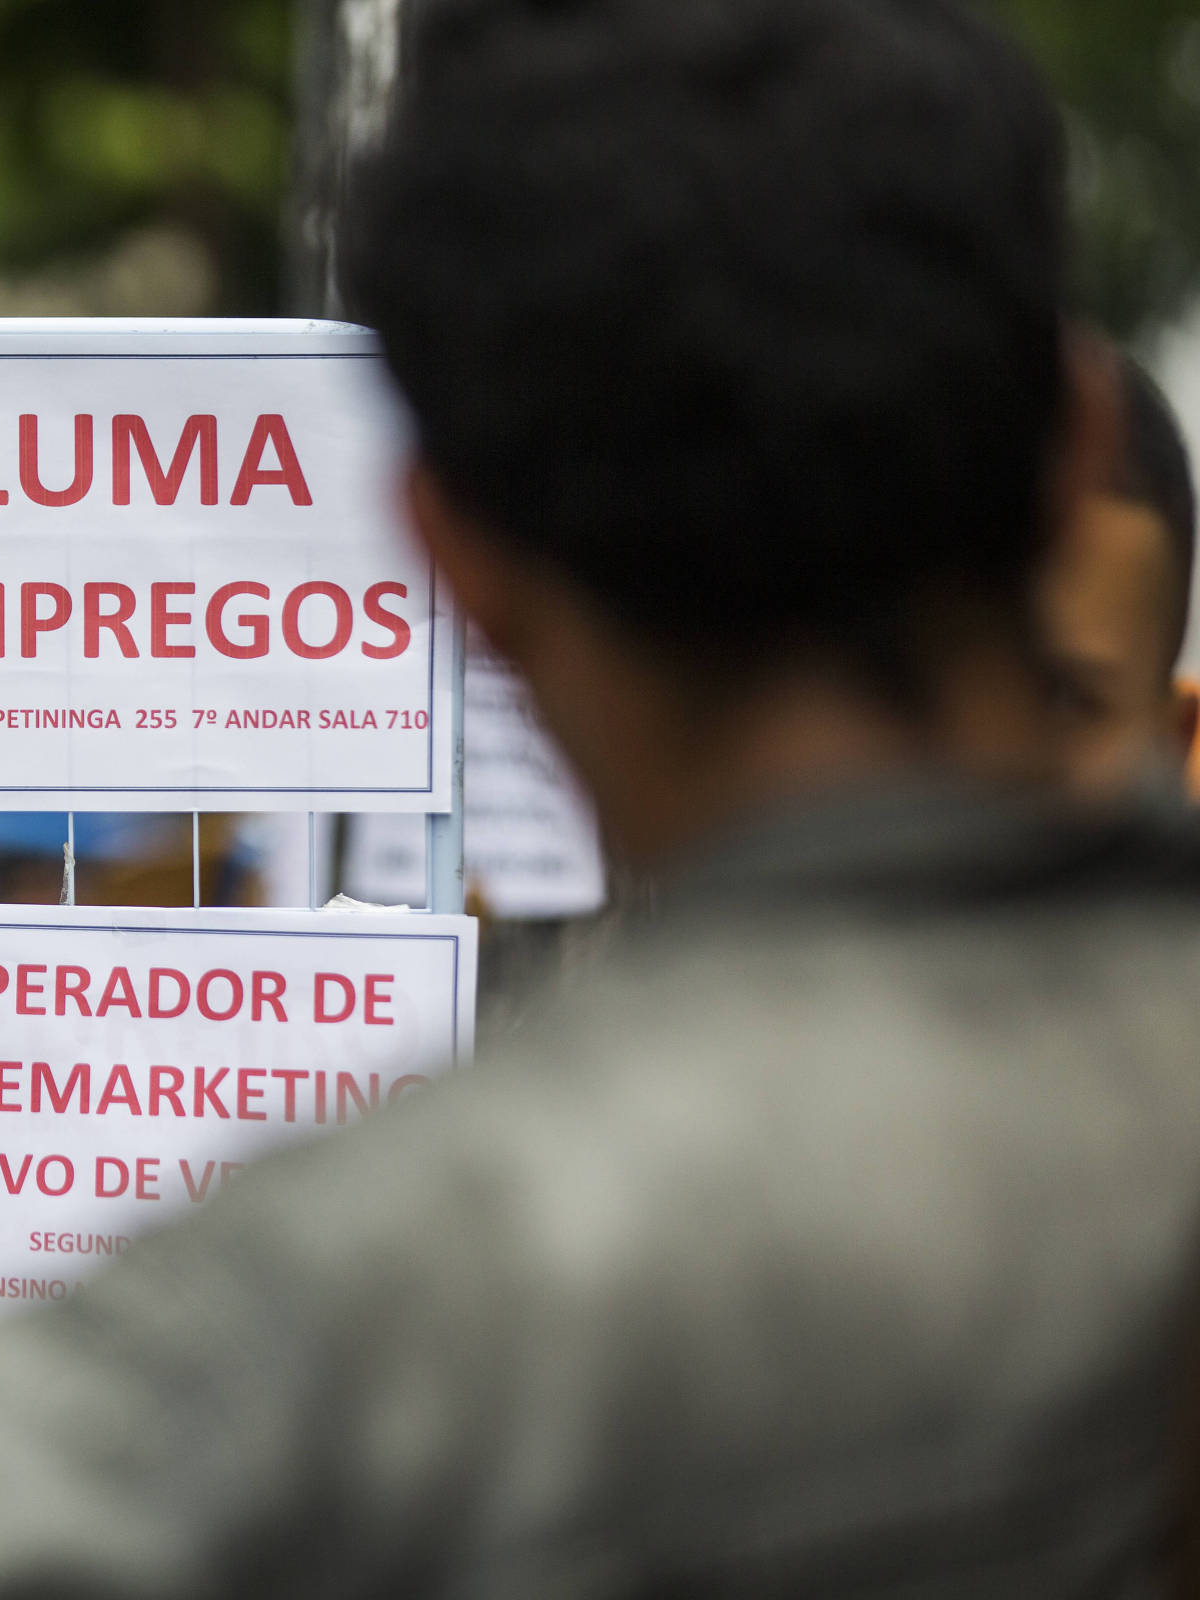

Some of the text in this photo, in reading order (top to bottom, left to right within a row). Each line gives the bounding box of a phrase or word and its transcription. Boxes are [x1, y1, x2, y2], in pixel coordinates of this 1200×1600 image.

[135, 709, 177, 729] 255
[224, 709, 311, 729] ANDAR
[318, 709, 378, 729] SALA
[385, 709, 429, 730] 710
[313, 972, 395, 1026] DE
[95, 1156, 161, 1200] DE
[29, 1231, 131, 1257] SEGUND
